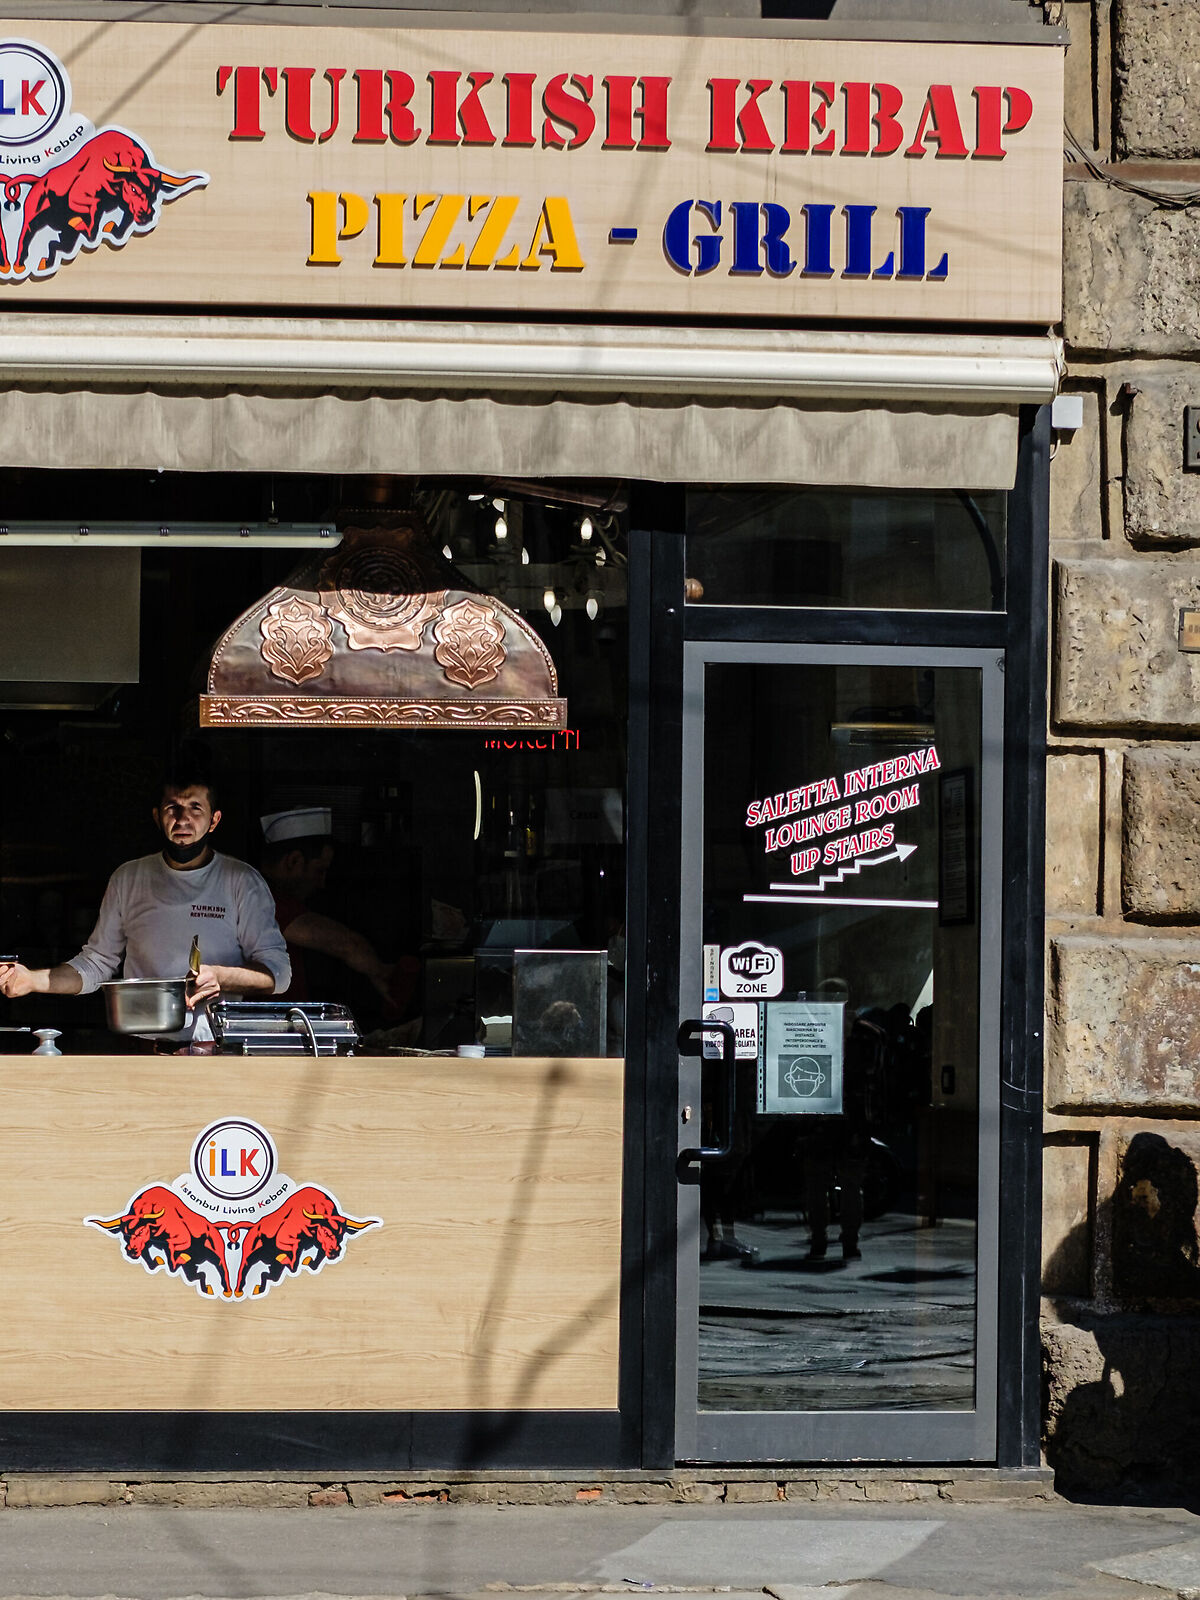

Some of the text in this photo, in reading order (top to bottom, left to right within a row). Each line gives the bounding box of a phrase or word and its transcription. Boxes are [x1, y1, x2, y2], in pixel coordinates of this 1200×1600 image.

[216, 65, 1034, 160] TURKISH KEBAP
[44, 124, 85, 157] Kebap
[306, 190, 586, 270] PIZZA
[663, 199, 949, 280] GRILL
[745, 746, 941, 827] SALETTA INTERNA
[765, 783, 920, 853] LOUNGE ROOM
[791, 823, 895, 876] UP STAIRS
[190, 911, 225, 920] RESTAURANT
[191, 904, 226, 913] TURKISH
[736, 983, 768, 993] ZONE
[735, 1028, 756, 1038] AREA
[223, 1206, 256, 1214] Living
[258, 1183, 289, 1208] Kebap
